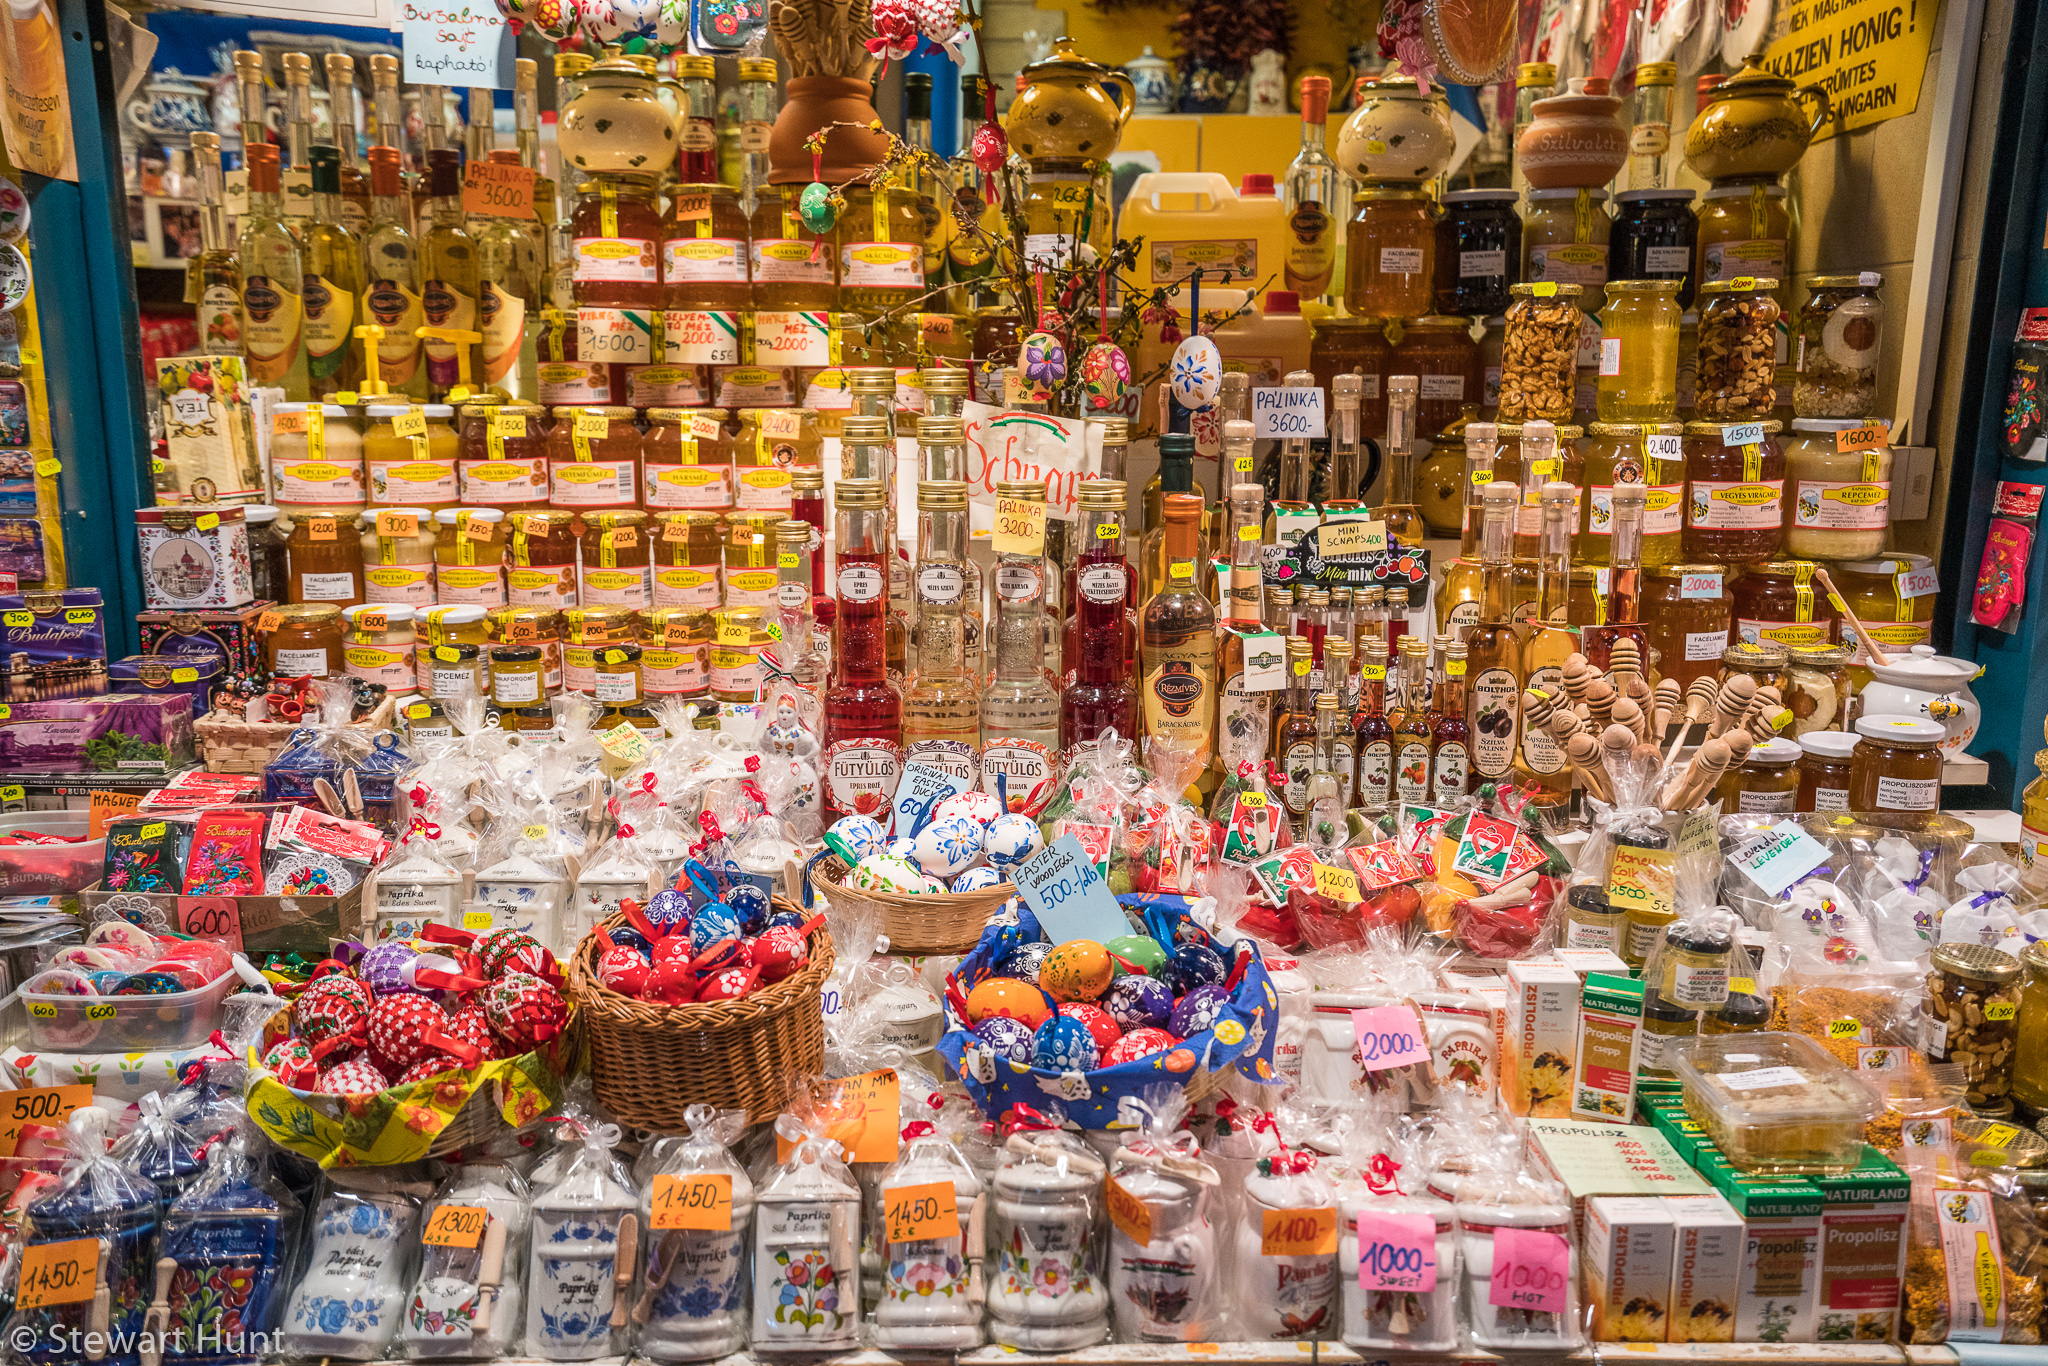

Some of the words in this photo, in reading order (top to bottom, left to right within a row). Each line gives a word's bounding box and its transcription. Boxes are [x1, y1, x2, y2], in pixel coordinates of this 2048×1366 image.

[404, 4, 505, 26] Birsalma
[436, 28, 476, 52] sajt
[1764, 34, 1832, 78] AKAZIEN
[1839, 83, 1897, 120] UNGARN
[1257, 391, 1319, 409] PÁLINKA
[1720, 492, 1746, 500] VEGYES
[1748, 491, 1780, 499] VIRÁGMÉZ
[1842, 491, 1881, 499] REPCEMÉZ
[998, 501, 1042, 518] PÁLINKA
[1338, 526, 1360, 536] MINI
[1317, 566, 1348, 581] Mini
[1348, 568, 1371, 582] mix
[1012, 582, 1029, 590] BARACK
[30, 598, 58, 608] TEA
[10, 613, 30, 624] 900
[69, 612, 94, 620] BLACK
[8, 625, 84, 646] Budapest
[1769, 632, 1793, 640] VEGYES
[1794, 630, 1825, 639] VIRÁGMÉZ
[433, 671, 470, 680] EPCEMÉZ
[1160, 682, 1199, 694] RÉZMÍVES
[1477, 685, 1516, 693] BOLYHOS
[42, 725, 81, 734] Lavender
[412, 730, 448, 738] EPCEMÉZ
[1478, 743, 1509, 752] PÁLINKA
[1480, 738, 1506, 746] SZILVA
[834, 762, 894, 778] FÜTYÜLŐS
[907, 764, 949, 783] ORIGINAL
[984, 760, 1042, 777] FÜTYÜLŐS
[3, 788, 18, 798] 400
[1750, 833, 1800, 869] LEVENDEL
[1616, 850, 1657, 866] Honey
[1014, 845, 1061, 886] EASTER
[12, 872, 70, 887] BUDAPEST
[388, 890, 424, 899] Paprika
[1651, 900, 1670, 911] 5€
[33, 1004, 54, 1016] 600
[90, 1006, 115, 1018] 600
[1585, 999, 1638, 1014] NATURLAND
[1524, 984, 1538, 1059] PROPOLISZ
[1585, 1027, 1631, 1043] Propolisz
[1441, 1040, 1488, 1065] PAPRIKA
[1593, 1044, 1621, 1056] csepp
[1538, 1126, 1628, 1138] PROPOLISZ
[1824, 1188, 1906, 1200] NATURLAND
[1749, 1204, 1819, 1215] NATURLAND
[786, 1211, 831, 1222] Paprika
[1829, 1227, 1898, 1246] Propolisz
[1747, 1240, 1817, 1257] Propolisz
[325, 1250, 382, 1269] Paprika
[1612, 1226, 1629, 1306] PROPOLISZ
[1680, 1228, 1698, 1308] PROPOLISZ
[1378, 1275, 1421, 1286] SWEET
[1494, 1262, 1562, 1290] 1000
[1512, 1291, 1545, 1303] HOT
